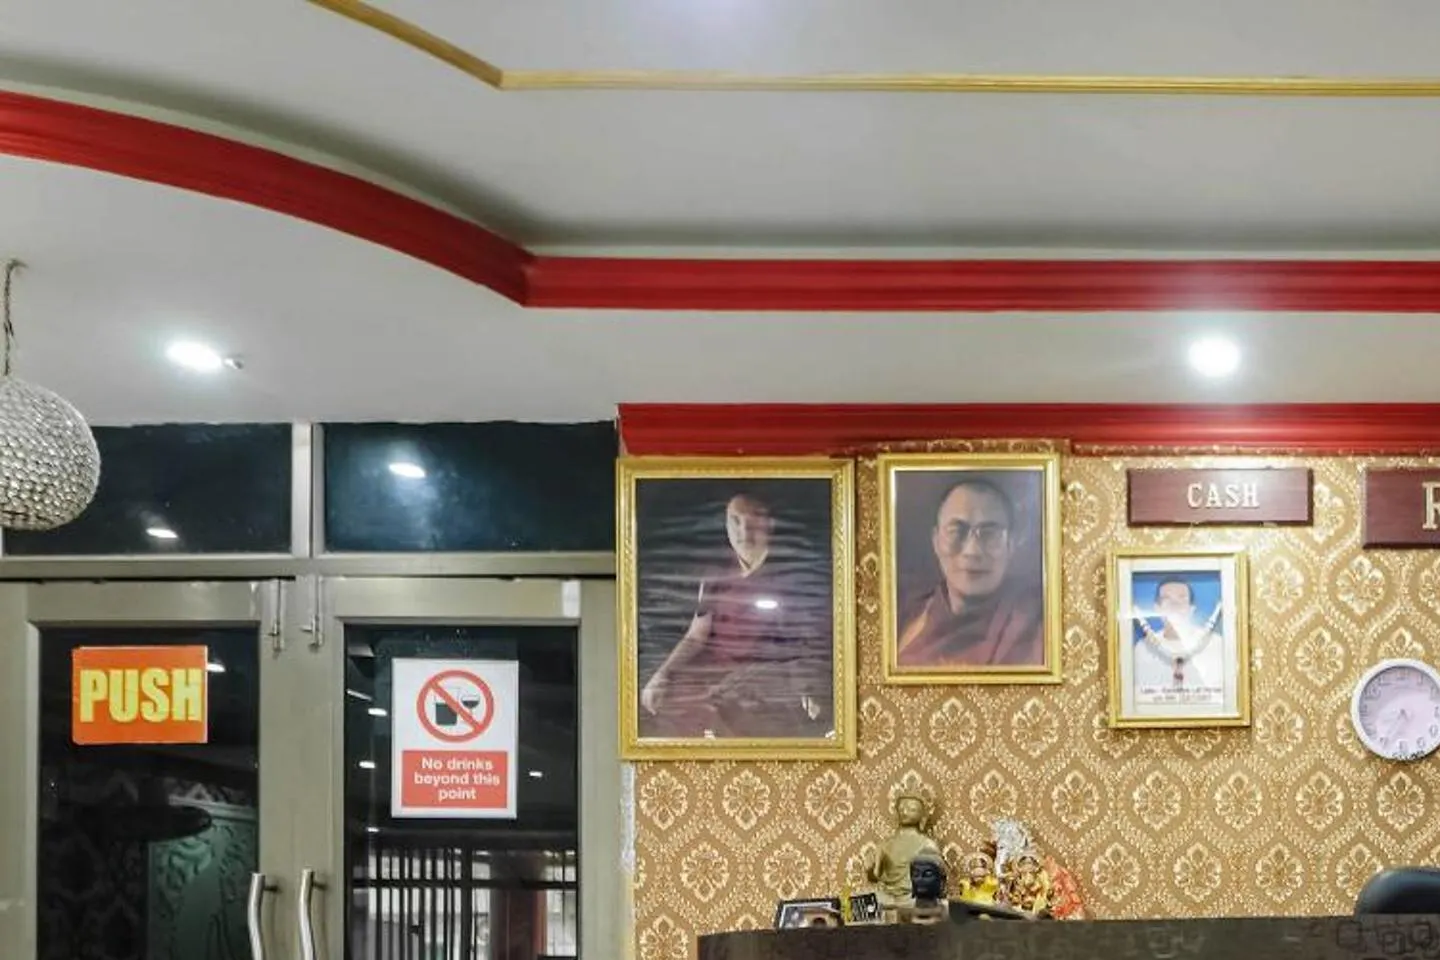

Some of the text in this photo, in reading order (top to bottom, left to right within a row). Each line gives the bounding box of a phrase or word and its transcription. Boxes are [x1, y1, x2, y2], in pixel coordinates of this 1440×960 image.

[1187, 483, 1260, 508] CASH
[80, 667, 202, 723] PUSH
[422, 758, 493, 770] No drinks
[414, 772, 500, 787] beyond this
[438, 787, 477, 802] point
